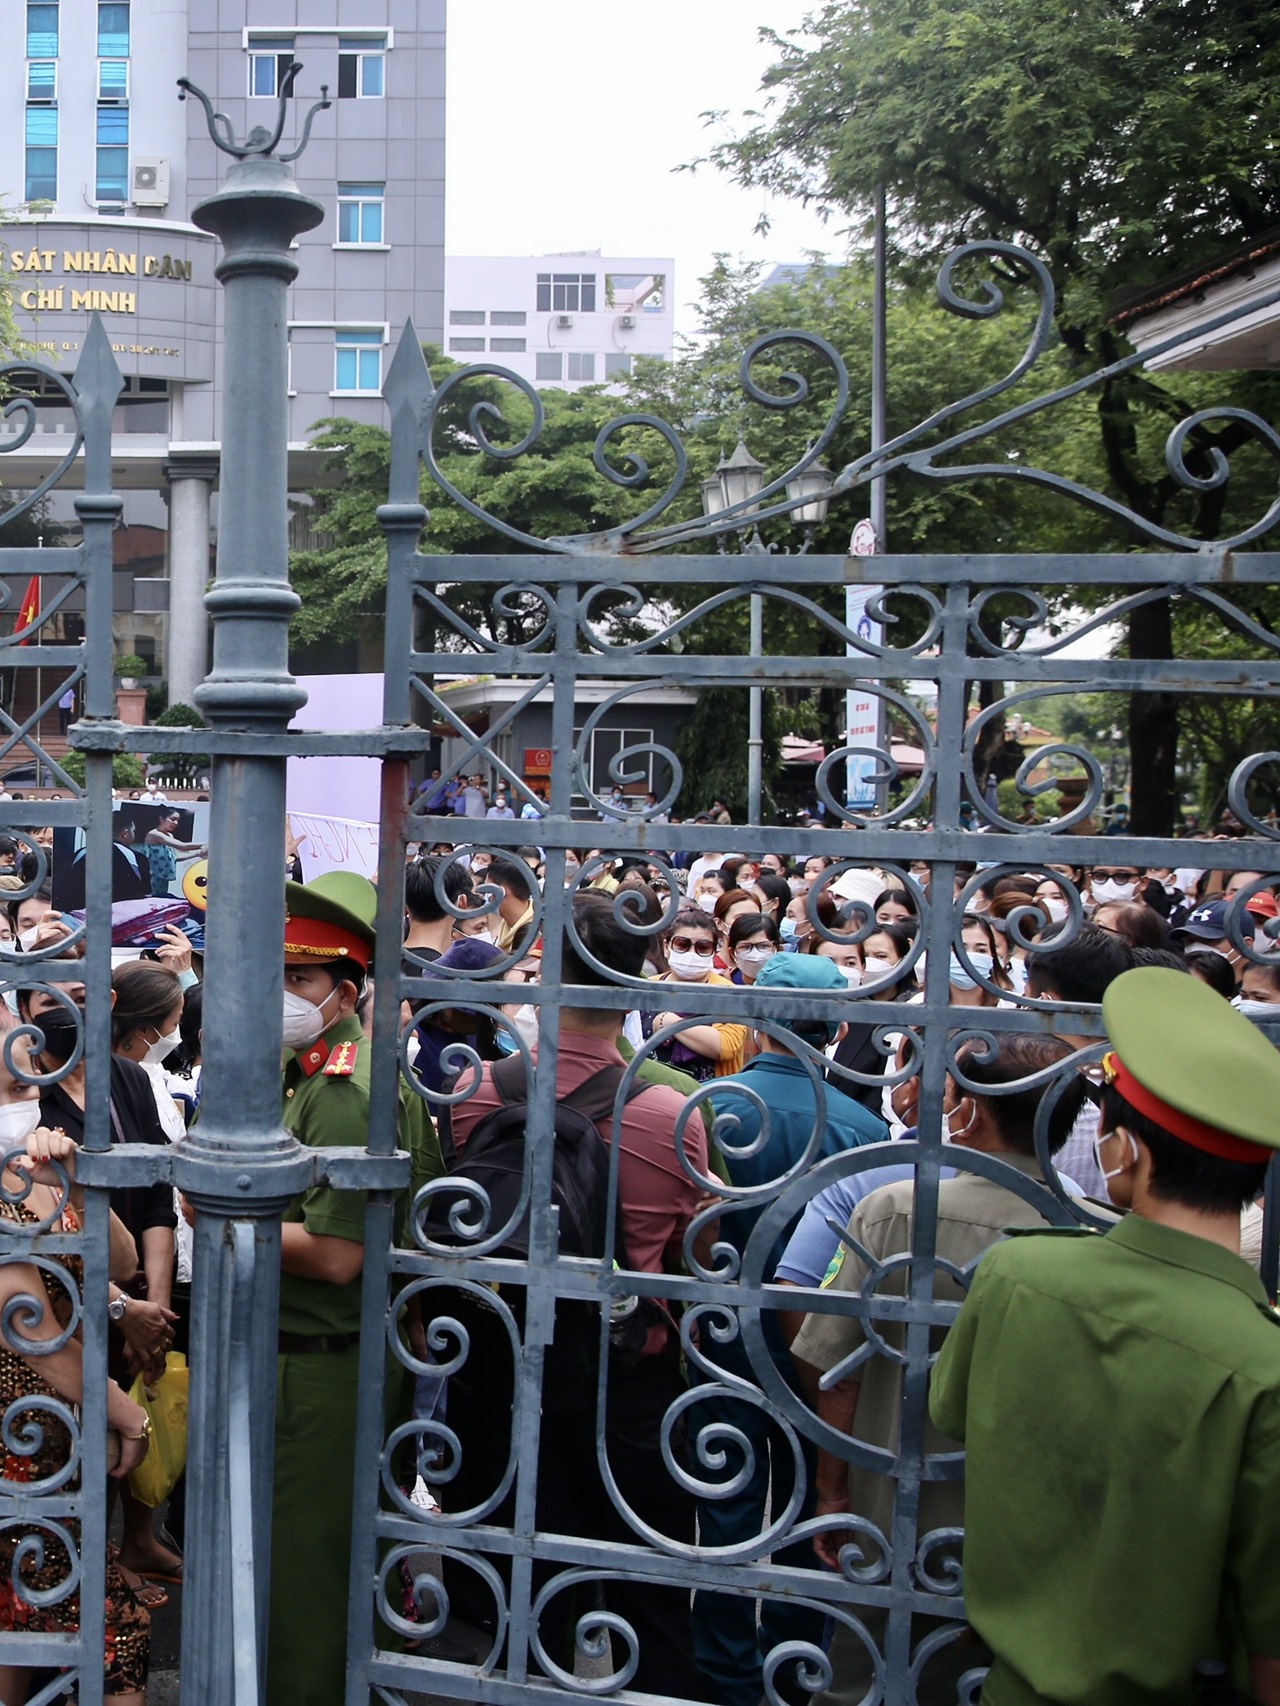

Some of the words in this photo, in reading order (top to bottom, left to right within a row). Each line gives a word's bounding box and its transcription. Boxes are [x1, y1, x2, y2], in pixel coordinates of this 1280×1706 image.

[11, 247, 57, 272] SÁT
[63, 248, 137, 275] NHÂN
[143, 254, 192, 280] DÂN
[20, 285, 65, 312] CHÍ
[71, 289, 136, 314] MINH
